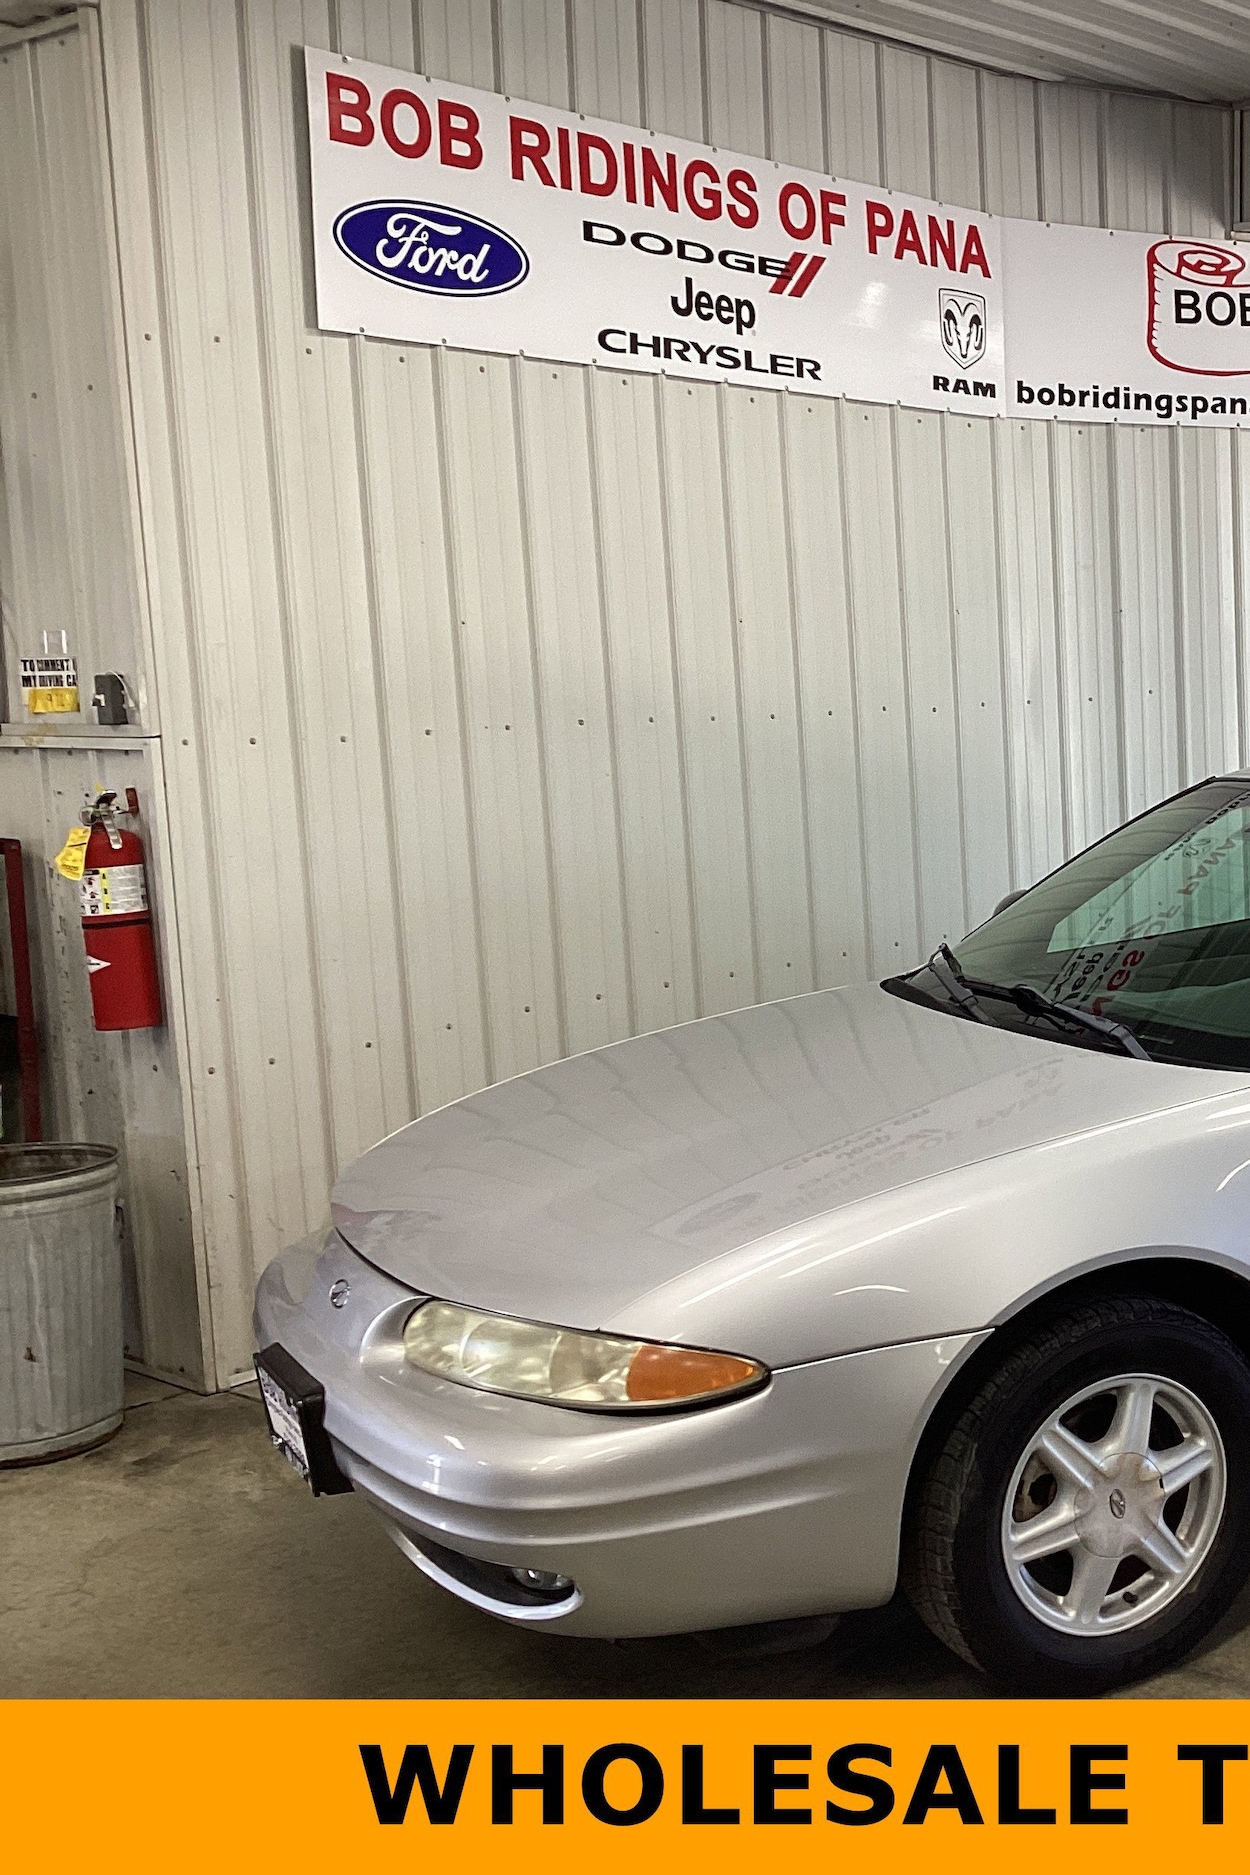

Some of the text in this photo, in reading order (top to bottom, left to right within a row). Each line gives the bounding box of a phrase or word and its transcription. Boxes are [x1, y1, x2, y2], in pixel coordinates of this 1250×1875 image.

[326, 72, 991, 278] BOB RIDINGS OF PANA
[376, 213, 491, 284] Ford
[583, 221, 794, 279] DODGE
[671, 277, 756, 336] Jeep
[598, 329, 822, 381] CHRYSLER
[933, 376, 996, 399] RAM
[21, 659, 35, 671] TO
